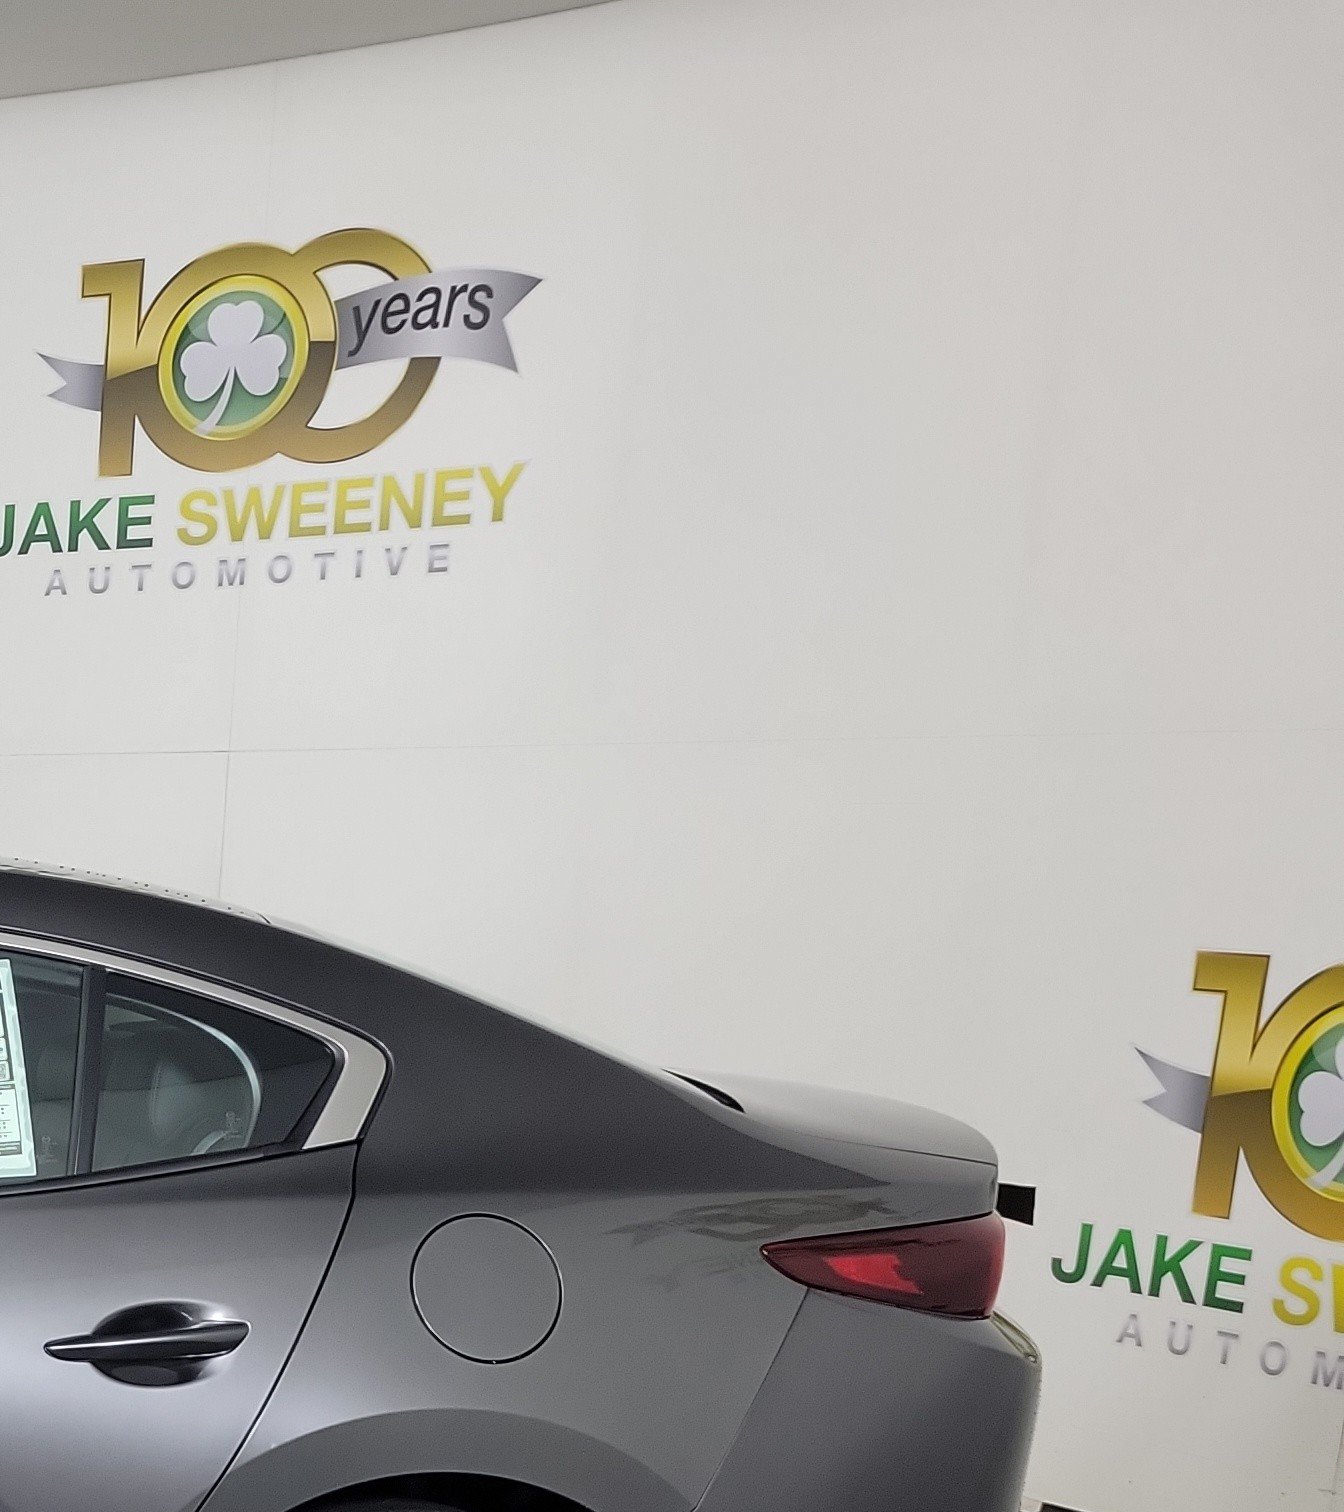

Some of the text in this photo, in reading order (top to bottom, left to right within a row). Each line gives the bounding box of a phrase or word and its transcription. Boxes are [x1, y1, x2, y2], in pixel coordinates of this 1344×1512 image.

[346, 282, 494, 357] years
[176, 462, 527, 547] SWEENEY
[44, 543, 451, 597] AUTOMOTIVE
[1051, 1222, 1253, 1314] JAKE
[1116, 1313, 1344, 1390] AUTOM
